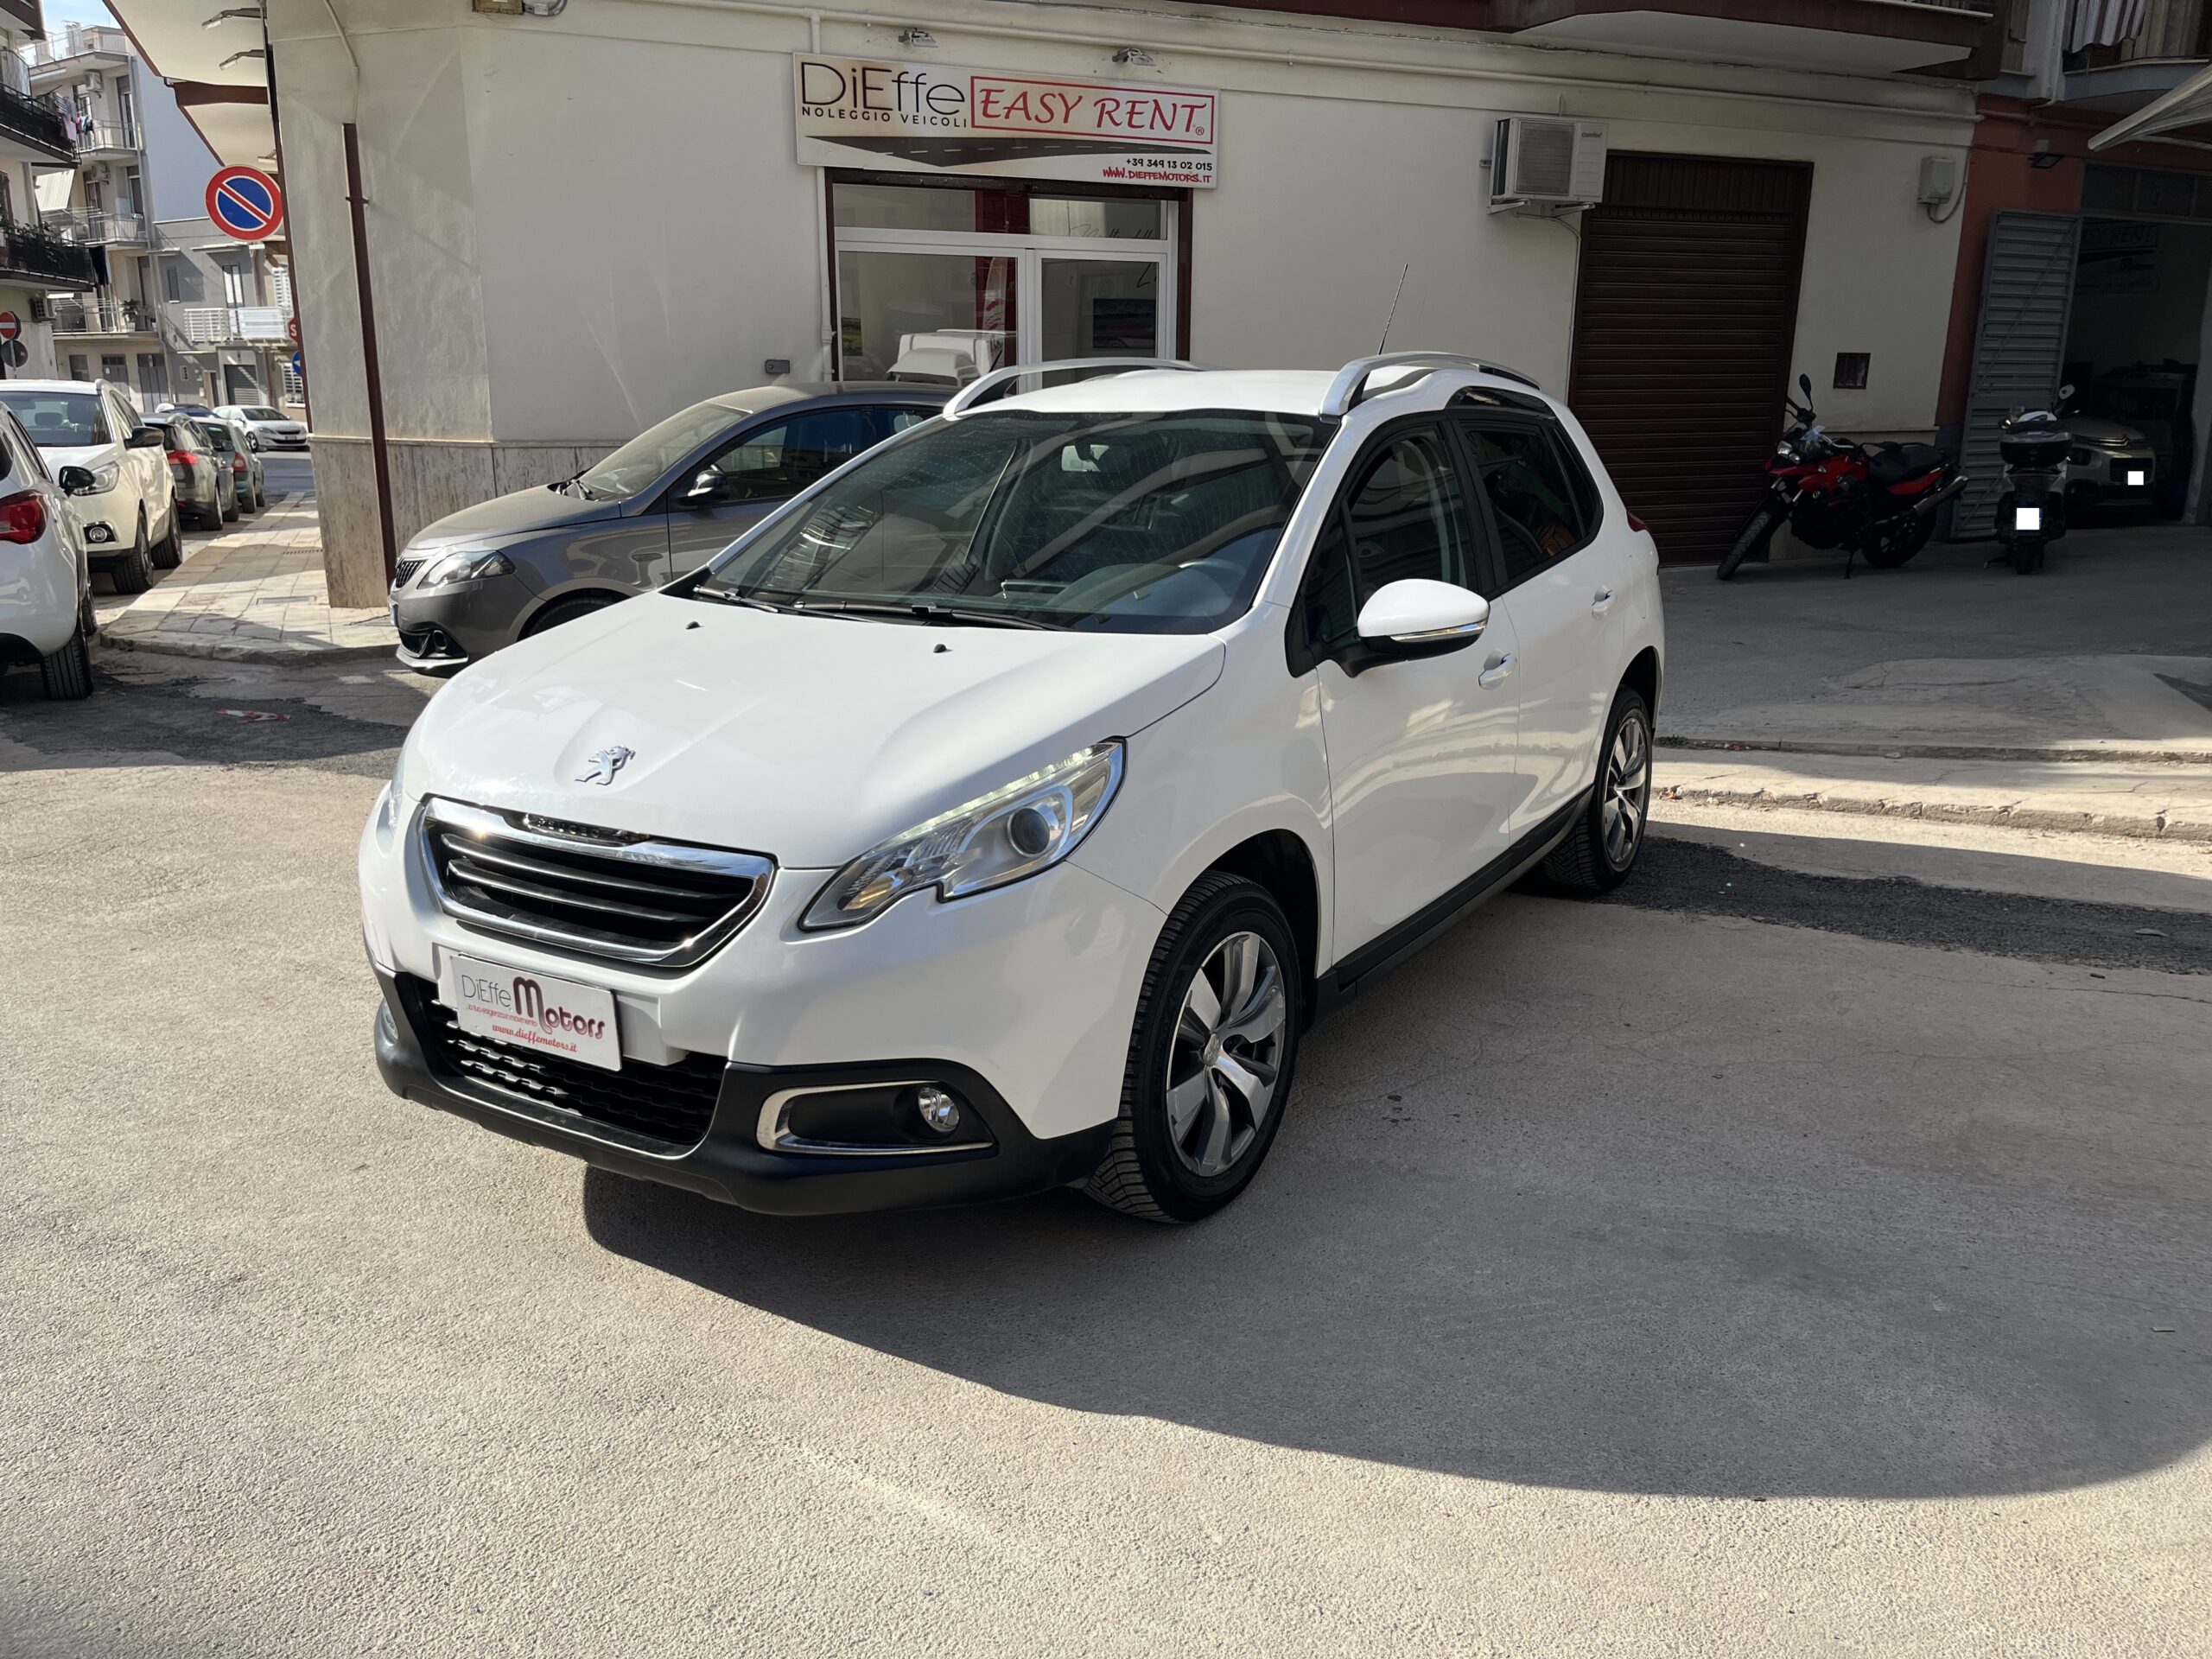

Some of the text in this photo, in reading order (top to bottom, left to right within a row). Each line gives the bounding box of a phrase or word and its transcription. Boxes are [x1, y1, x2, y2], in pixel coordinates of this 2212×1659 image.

[801, 61, 965, 116] DiEffe
[802, 106, 967, 128] NOLEGGIO VEICOLI
[980, 88, 1207, 132] EASY RENT
[1126, 158, 1212, 171] +39 349 13 02 015
[461, 974, 512, 1007] DiEffe
[492, 1024, 578, 1053] www.dieffemotors.it
